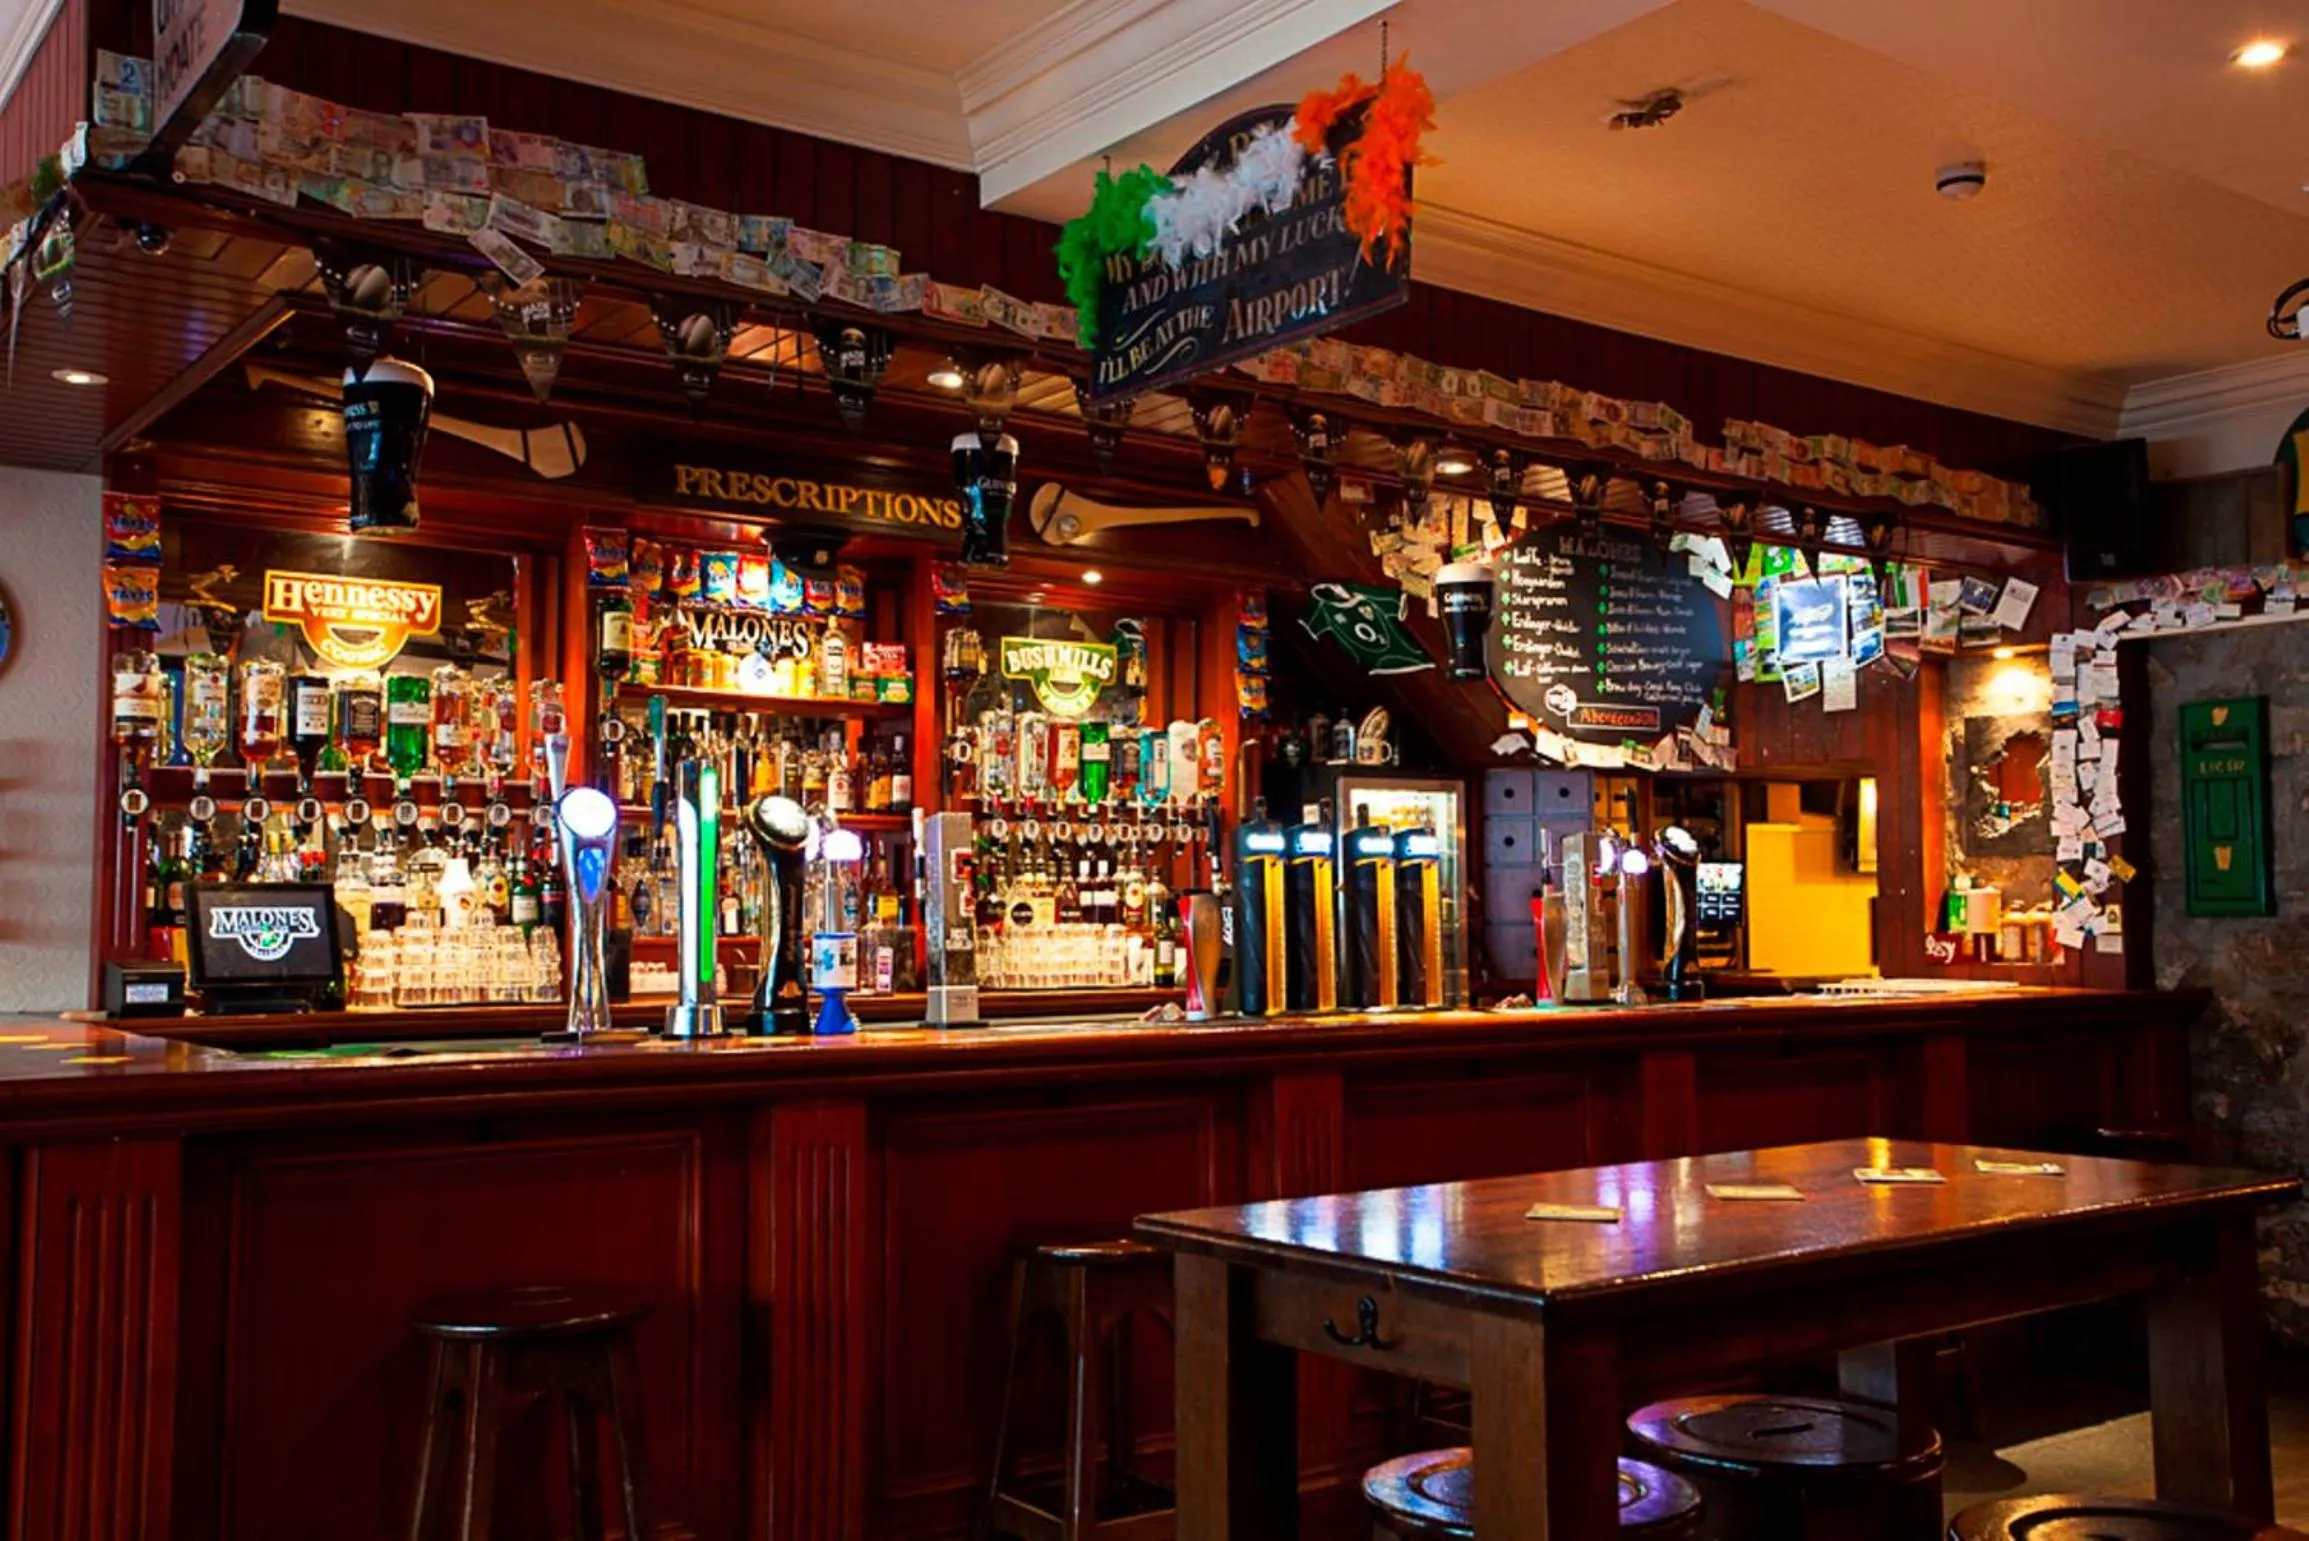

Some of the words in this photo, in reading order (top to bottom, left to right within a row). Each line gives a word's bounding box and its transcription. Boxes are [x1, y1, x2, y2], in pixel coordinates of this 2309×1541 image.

[1121, 273, 1168, 315] AND
[1235, 229, 1275, 271] MY
[1098, 355, 1129, 384] I'LL
[1129, 336, 1153, 371] BE
[1155, 318, 1177, 351] AT
[1176, 304, 1216, 333] THE
[674, 464, 962, 528] PRESCRIPTIONS
[270, 578, 438, 623] Hennessy
[687, 611, 810, 658] MALONES
[1006, 645, 1114, 680] BUSHMILLS
[215, 908, 312, 934] MALONES
